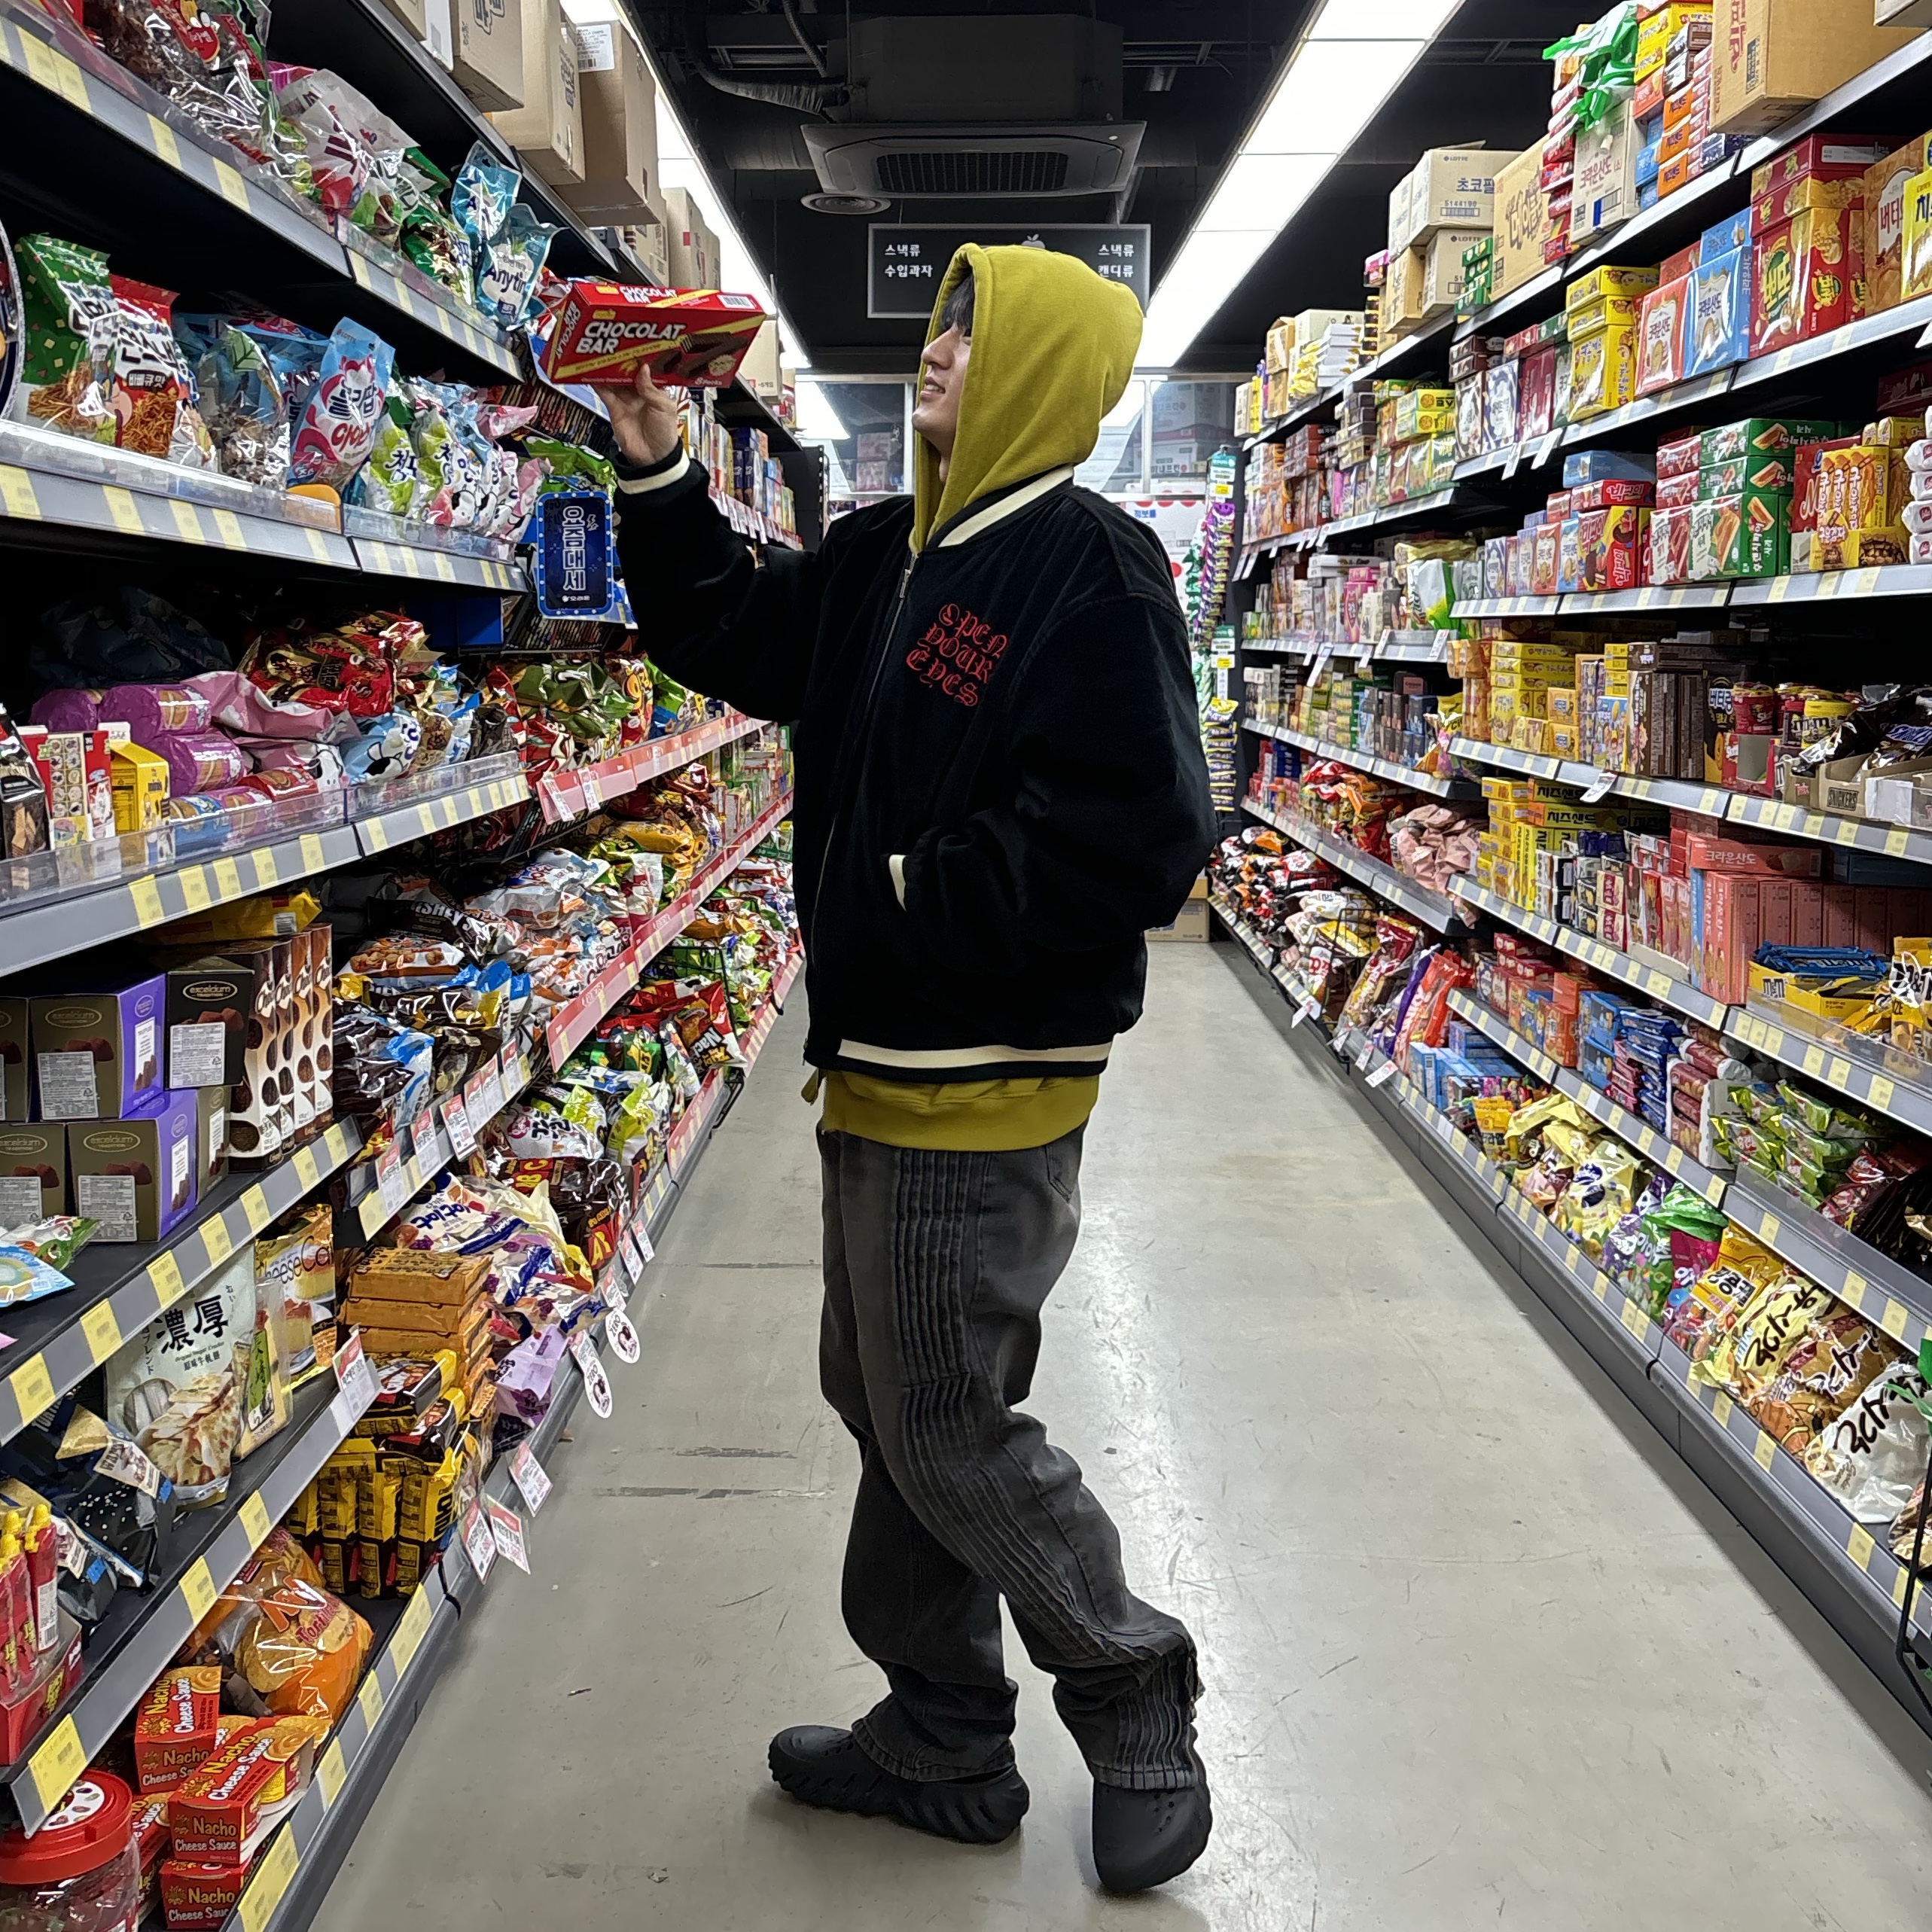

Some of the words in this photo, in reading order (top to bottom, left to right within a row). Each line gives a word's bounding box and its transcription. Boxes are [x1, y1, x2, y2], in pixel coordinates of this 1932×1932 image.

[1879, 197, 1903, 234] 버터
[1916, 193, 1932, 224] 치
[884, 243, 921, 257] 스낵류
[1097, 243, 1135, 257] 스낵류
[884, 264, 934, 278] 수입과자
[1097, 264, 1135, 279] 캔디류
[620, 285, 678, 298] CHOCOLAT
[624, 294, 651, 304] BAR
[584, 321, 687, 340] CHOCOLAT
[575, 338, 620, 354] BAR
[1606, 483, 1645, 502] 빅파이
[1849, 466, 1861, 530] 구운감자
[562, 505, 587, 591] 요즘대세
[1751, 522, 1766, 573] 후렌치파이
[1612, 548, 1632, 587] 빅파이
[938, 602, 1008, 659] OPEN
[917, 621, 993, 684] YOUR
[906, 648, 979, 708] EYES
[1547, 810, 1597, 823] 치즈샌드
[1705, 850, 1757, 865] 크라운산도
[156, 1296, 230, 1355] 濃厚
[145, 1678, 171, 1715] Nacho
[172, 1677, 191, 1702] Sauce
[173, 1701, 196, 1733] Cheese
[163, 1748, 210, 1766] Nacho
[201, 1735, 257, 1775] Nacho
[207, 1763, 251, 1800] Cheese
[237, 1736, 275, 1765] Sauce
[142, 1772, 178, 1787] Cheese
[193, 1815, 237, 1836] Nacho
[175, 1839, 208, 1852] Cheese
[209, 1839, 237, 1851] Sauce
[187, 1887, 235, 1905] Nacho
[168, 1909, 203, 1922] Cheese
[204, 1906, 229, 1919] Sauc
